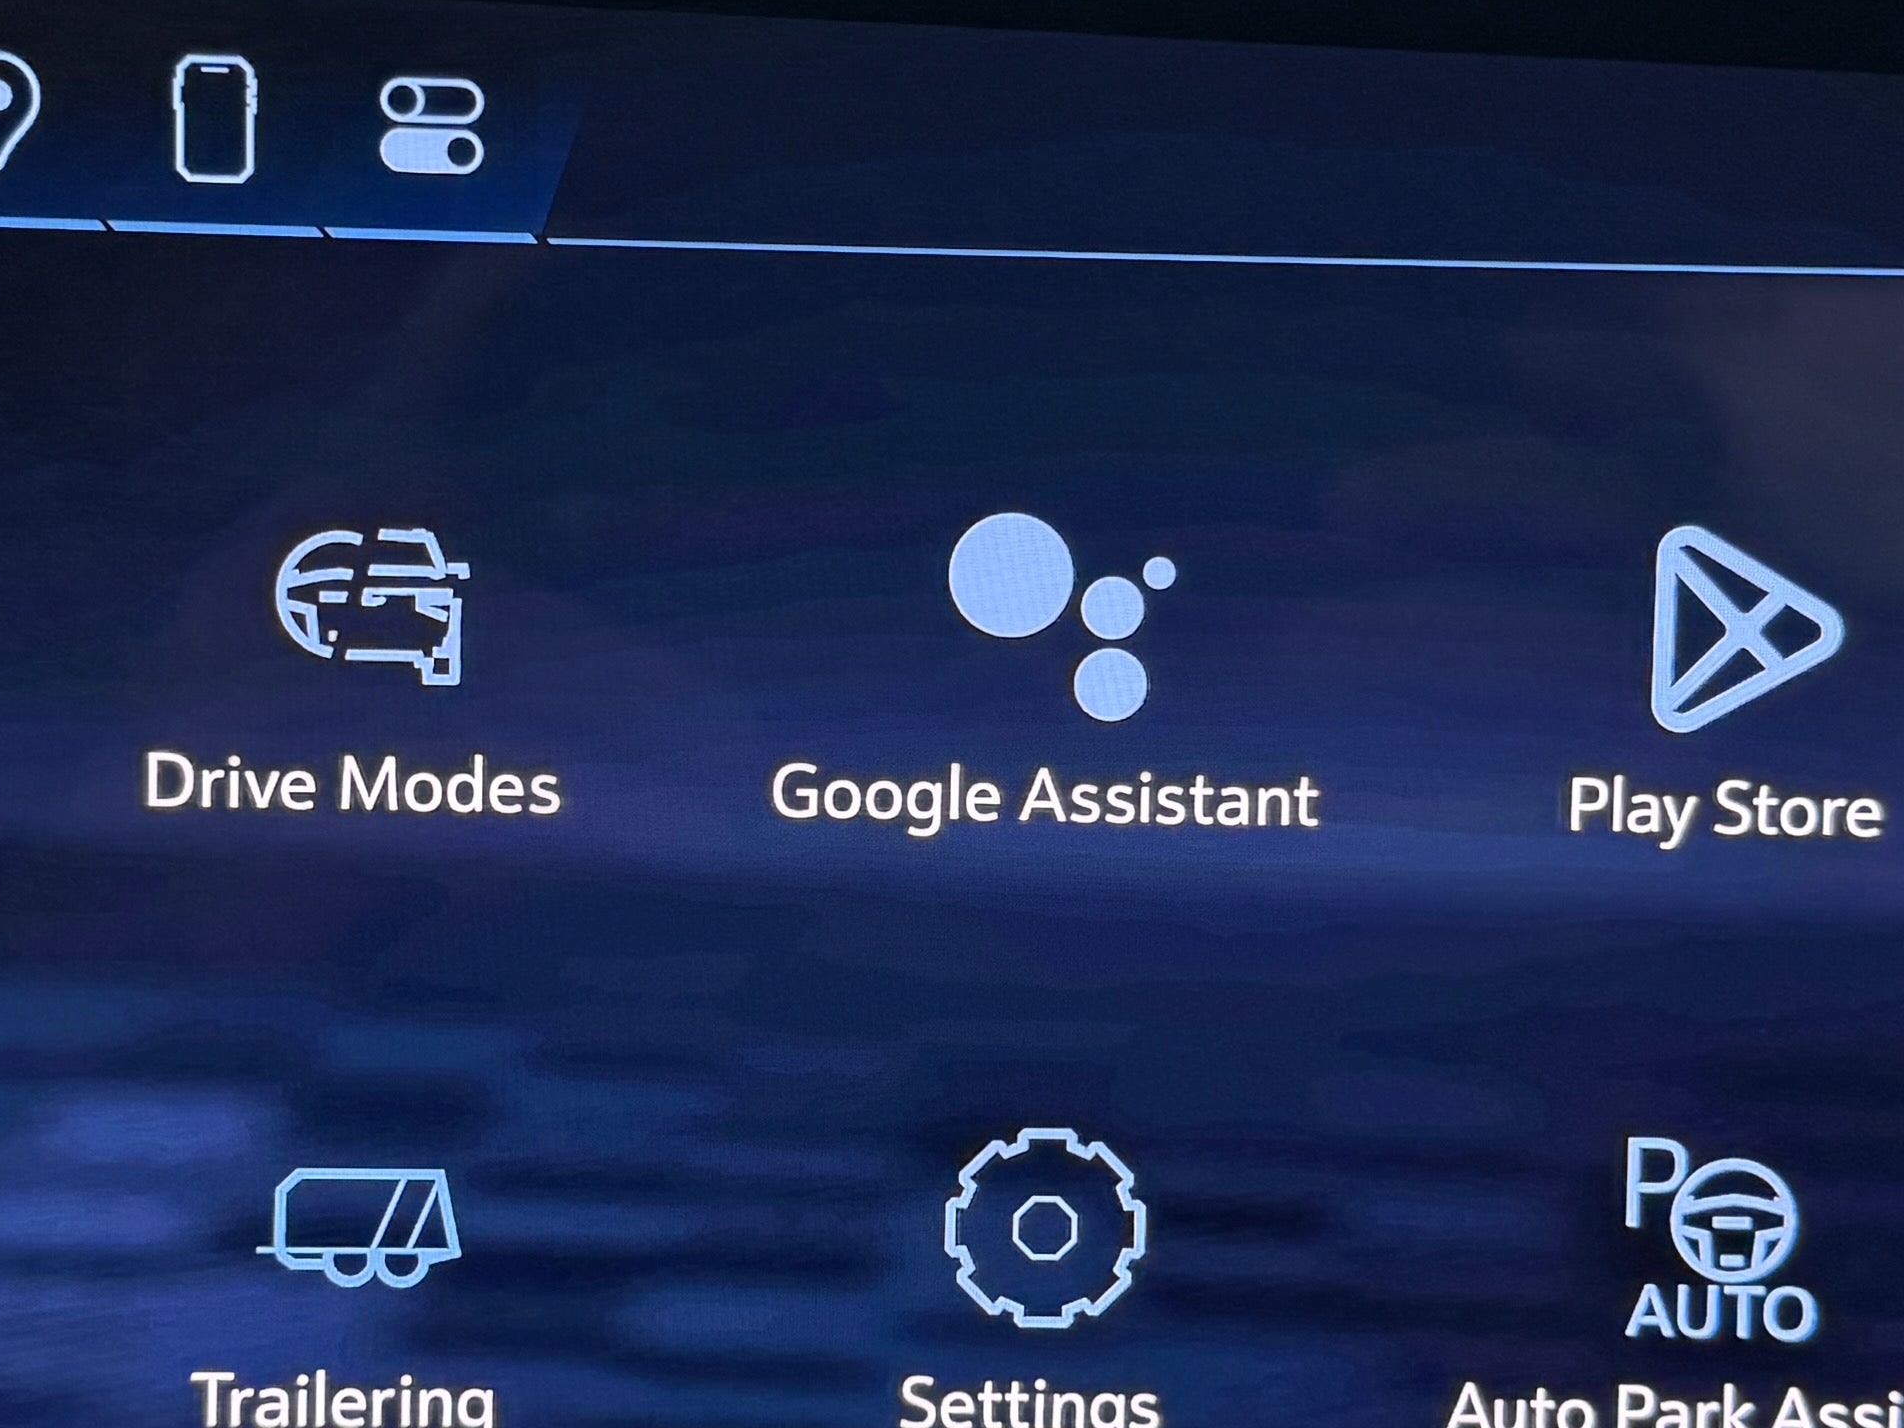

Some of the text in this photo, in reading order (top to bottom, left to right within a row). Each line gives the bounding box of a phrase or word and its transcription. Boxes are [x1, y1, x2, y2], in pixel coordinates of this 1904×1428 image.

[147, 751, 560, 814] Drive Modes
[773, 763, 1319, 837] Google Assistant
[1571, 775, 1884, 849] Play Store
[1626, 1137, 1689, 1229] P
[1625, 1283, 1817, 1341] AUTO
